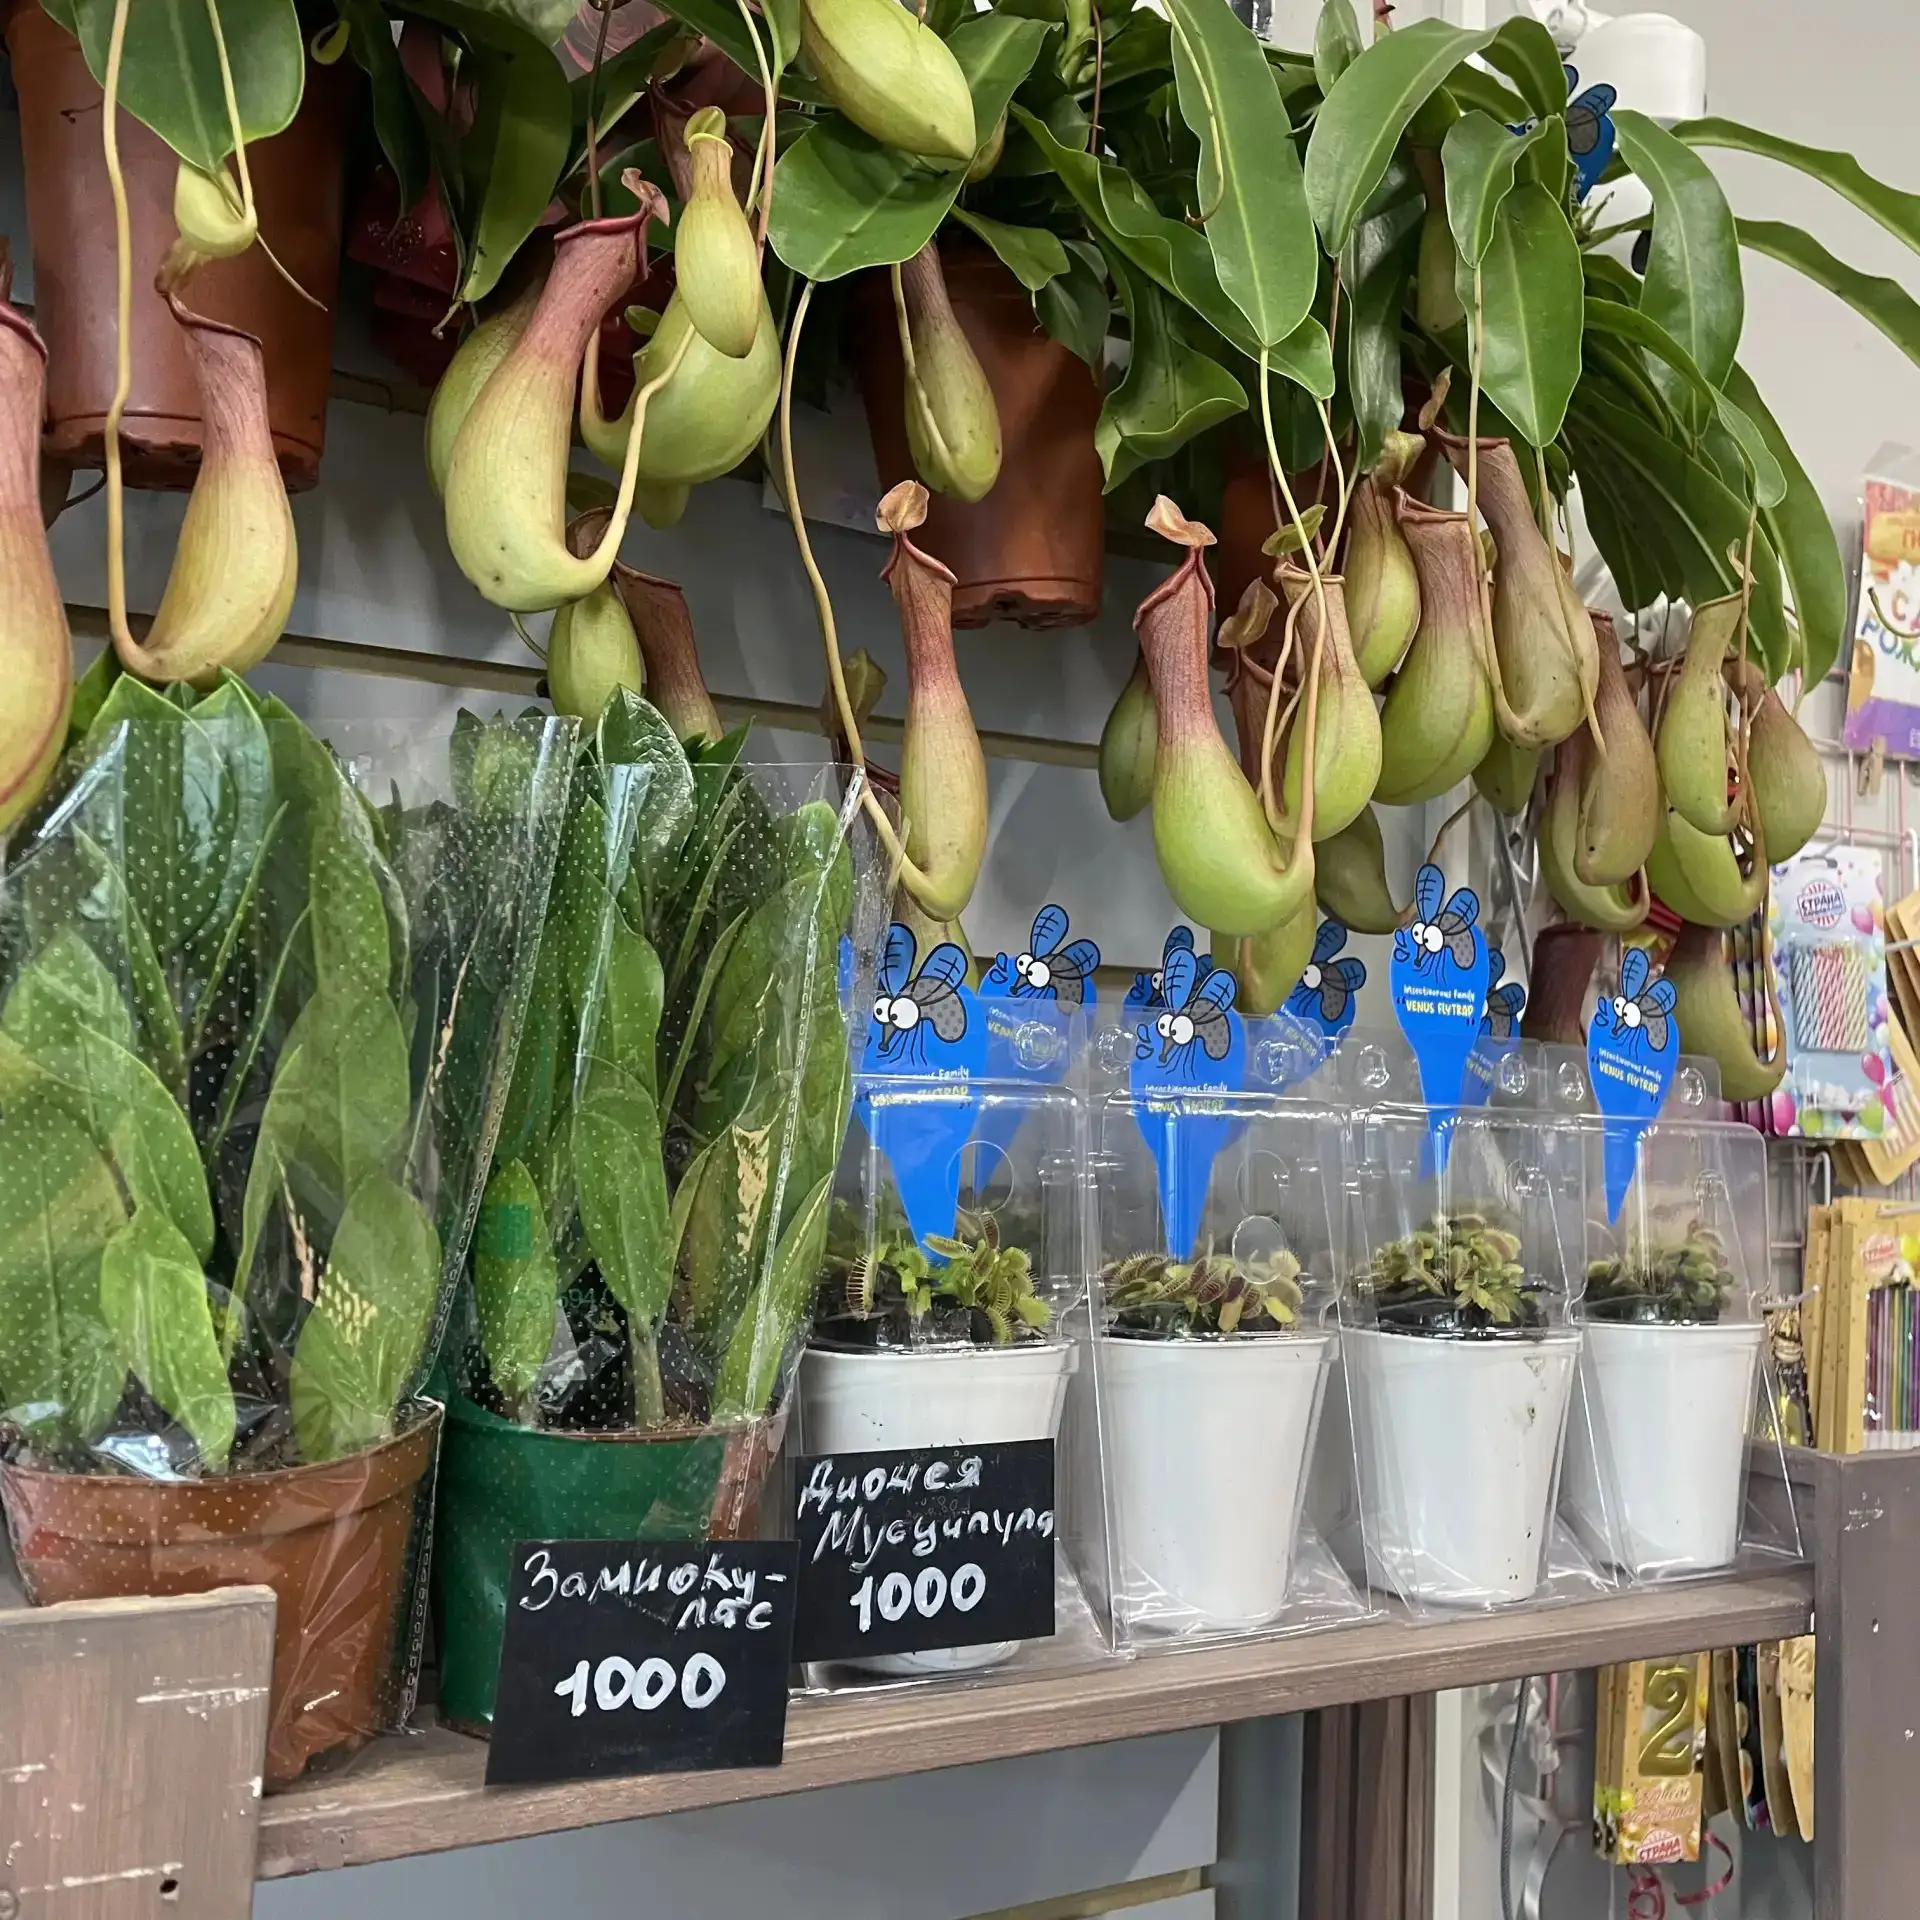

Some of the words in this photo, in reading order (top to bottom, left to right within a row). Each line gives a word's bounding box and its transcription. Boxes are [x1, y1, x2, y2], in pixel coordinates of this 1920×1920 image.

[850, 1562, 987, 1633] 1000
[554, 1652, 727, 1717] 1000
[1638, 1665, 1691, 1776] 2
